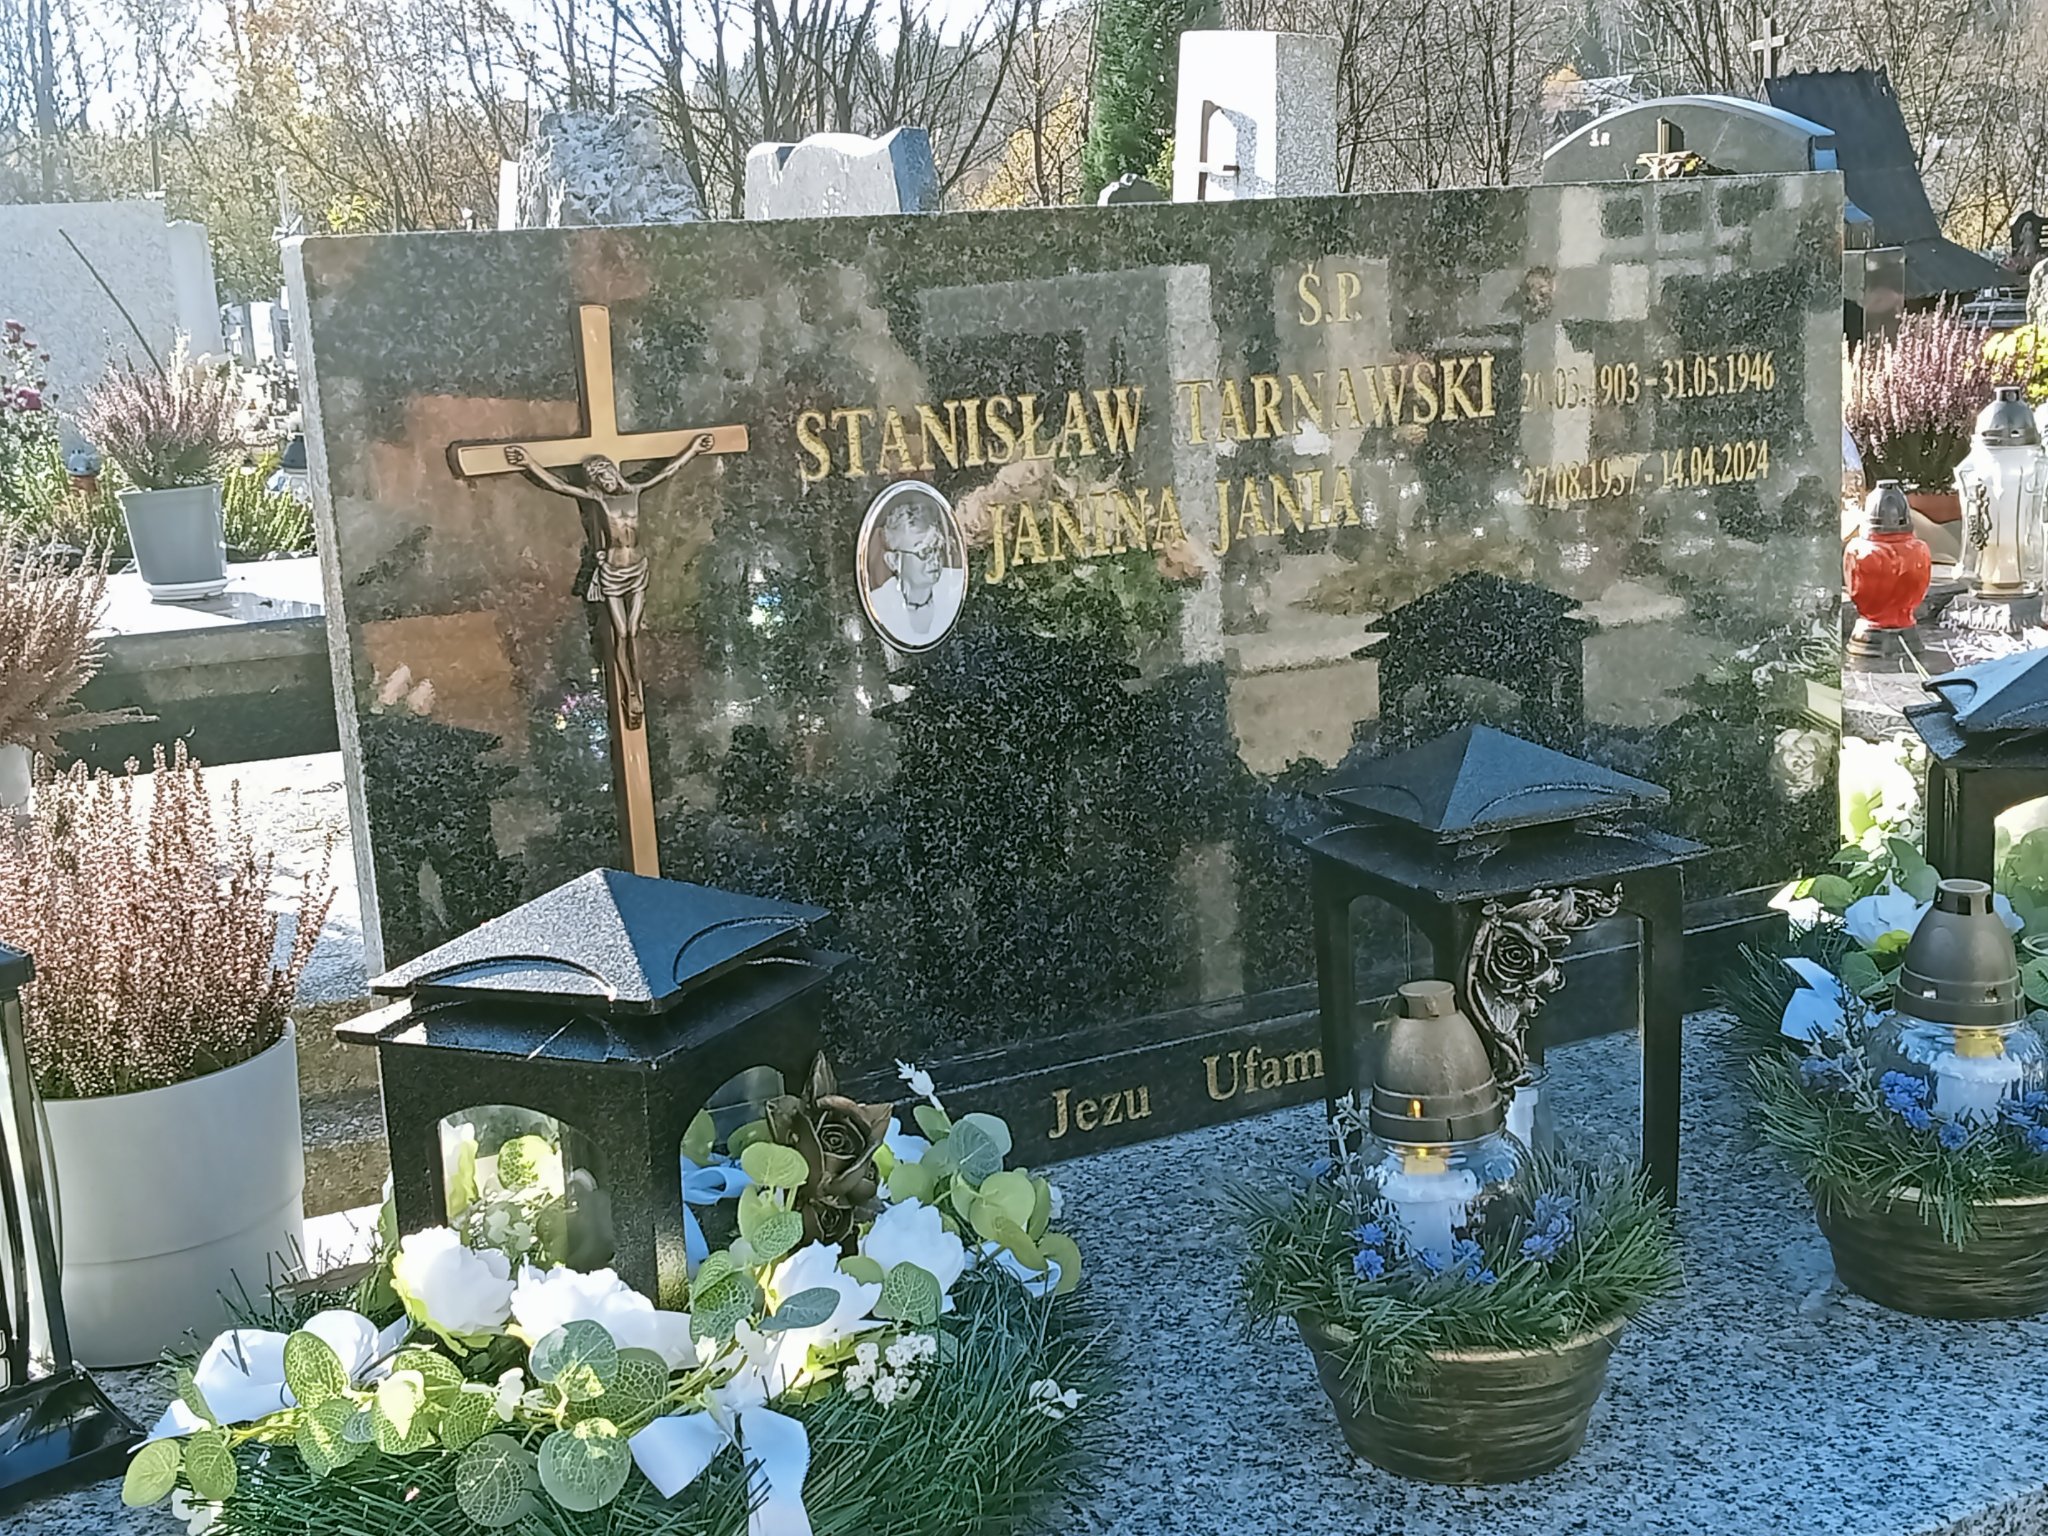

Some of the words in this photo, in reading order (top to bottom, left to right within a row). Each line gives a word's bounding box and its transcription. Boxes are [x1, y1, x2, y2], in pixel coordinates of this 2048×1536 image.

[1298, 263, 1363, 326] Ś.P.
[796, 385, 1145, 482] STANISŁAW
[1176, 352, 1496, 446] TARNAWSKI
[1662, 351, 1776, 401] 31.05.1946
[984, 486, 1188, 583] JANINA
[1212, 467, 1361, 557] JANIA
[1660, 440, 1769, 490] 14.04.2024
[1047, 1085, 1152, 1139] Jezu
[1202, 1045, 1326, 1101] Ufam
